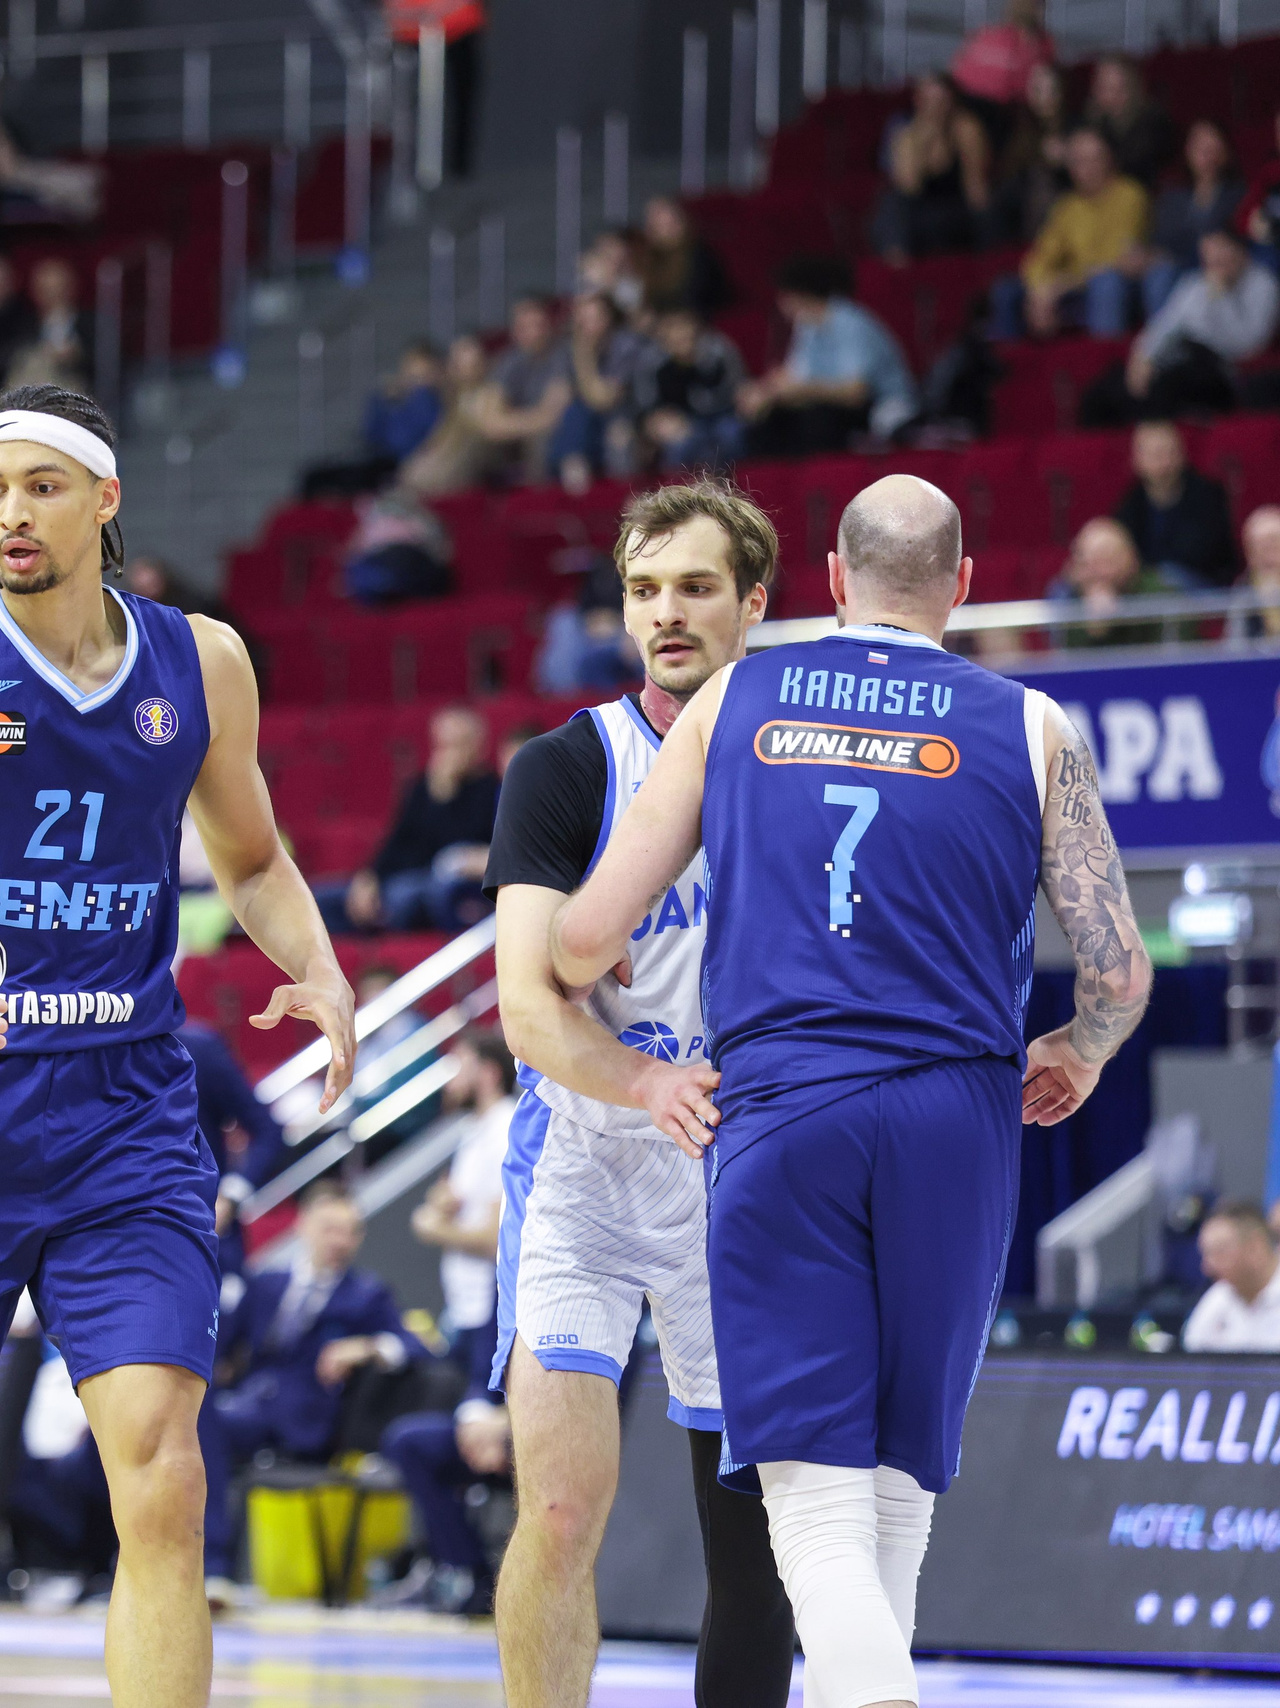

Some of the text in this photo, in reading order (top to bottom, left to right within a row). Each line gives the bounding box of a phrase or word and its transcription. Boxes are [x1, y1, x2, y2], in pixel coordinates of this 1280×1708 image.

[779, 667, 953, 718] KARASEV
[771, 731, 915, 764] WINLINE
[23, 789, 105, 862] 21
[823, 784, 880, 938] 7
[7, 990, 135, 1025] ГАЗПРОМ
[536, 1334, 579, 1346] ZEDO
[1056, 1386, 1280, 1464] REALLI
